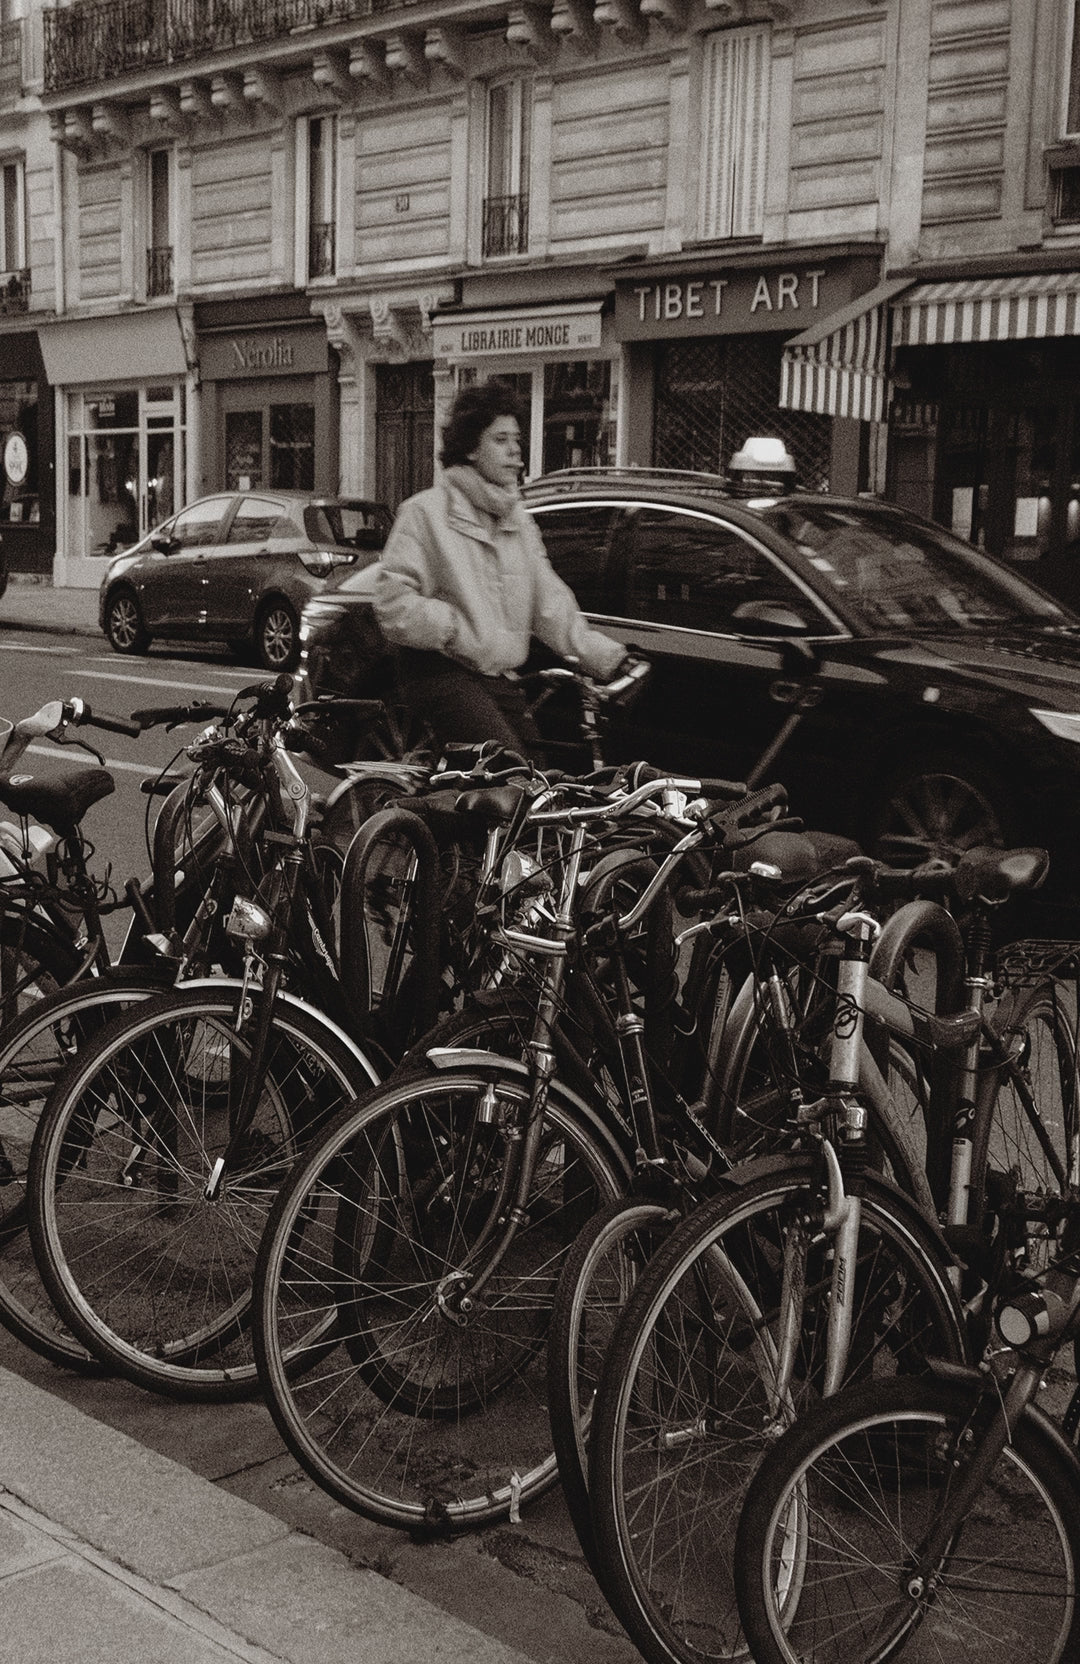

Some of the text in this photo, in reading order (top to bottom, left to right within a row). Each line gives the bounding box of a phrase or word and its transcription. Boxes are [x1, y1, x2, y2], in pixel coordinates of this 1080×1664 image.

[634, 270, 825, 321] TIBET ART
[232, 338, 293, 368] Nérolia
[461, 328, 522, 351] LIBRAIRIE
[526, 325, 570, 347] MONGE
